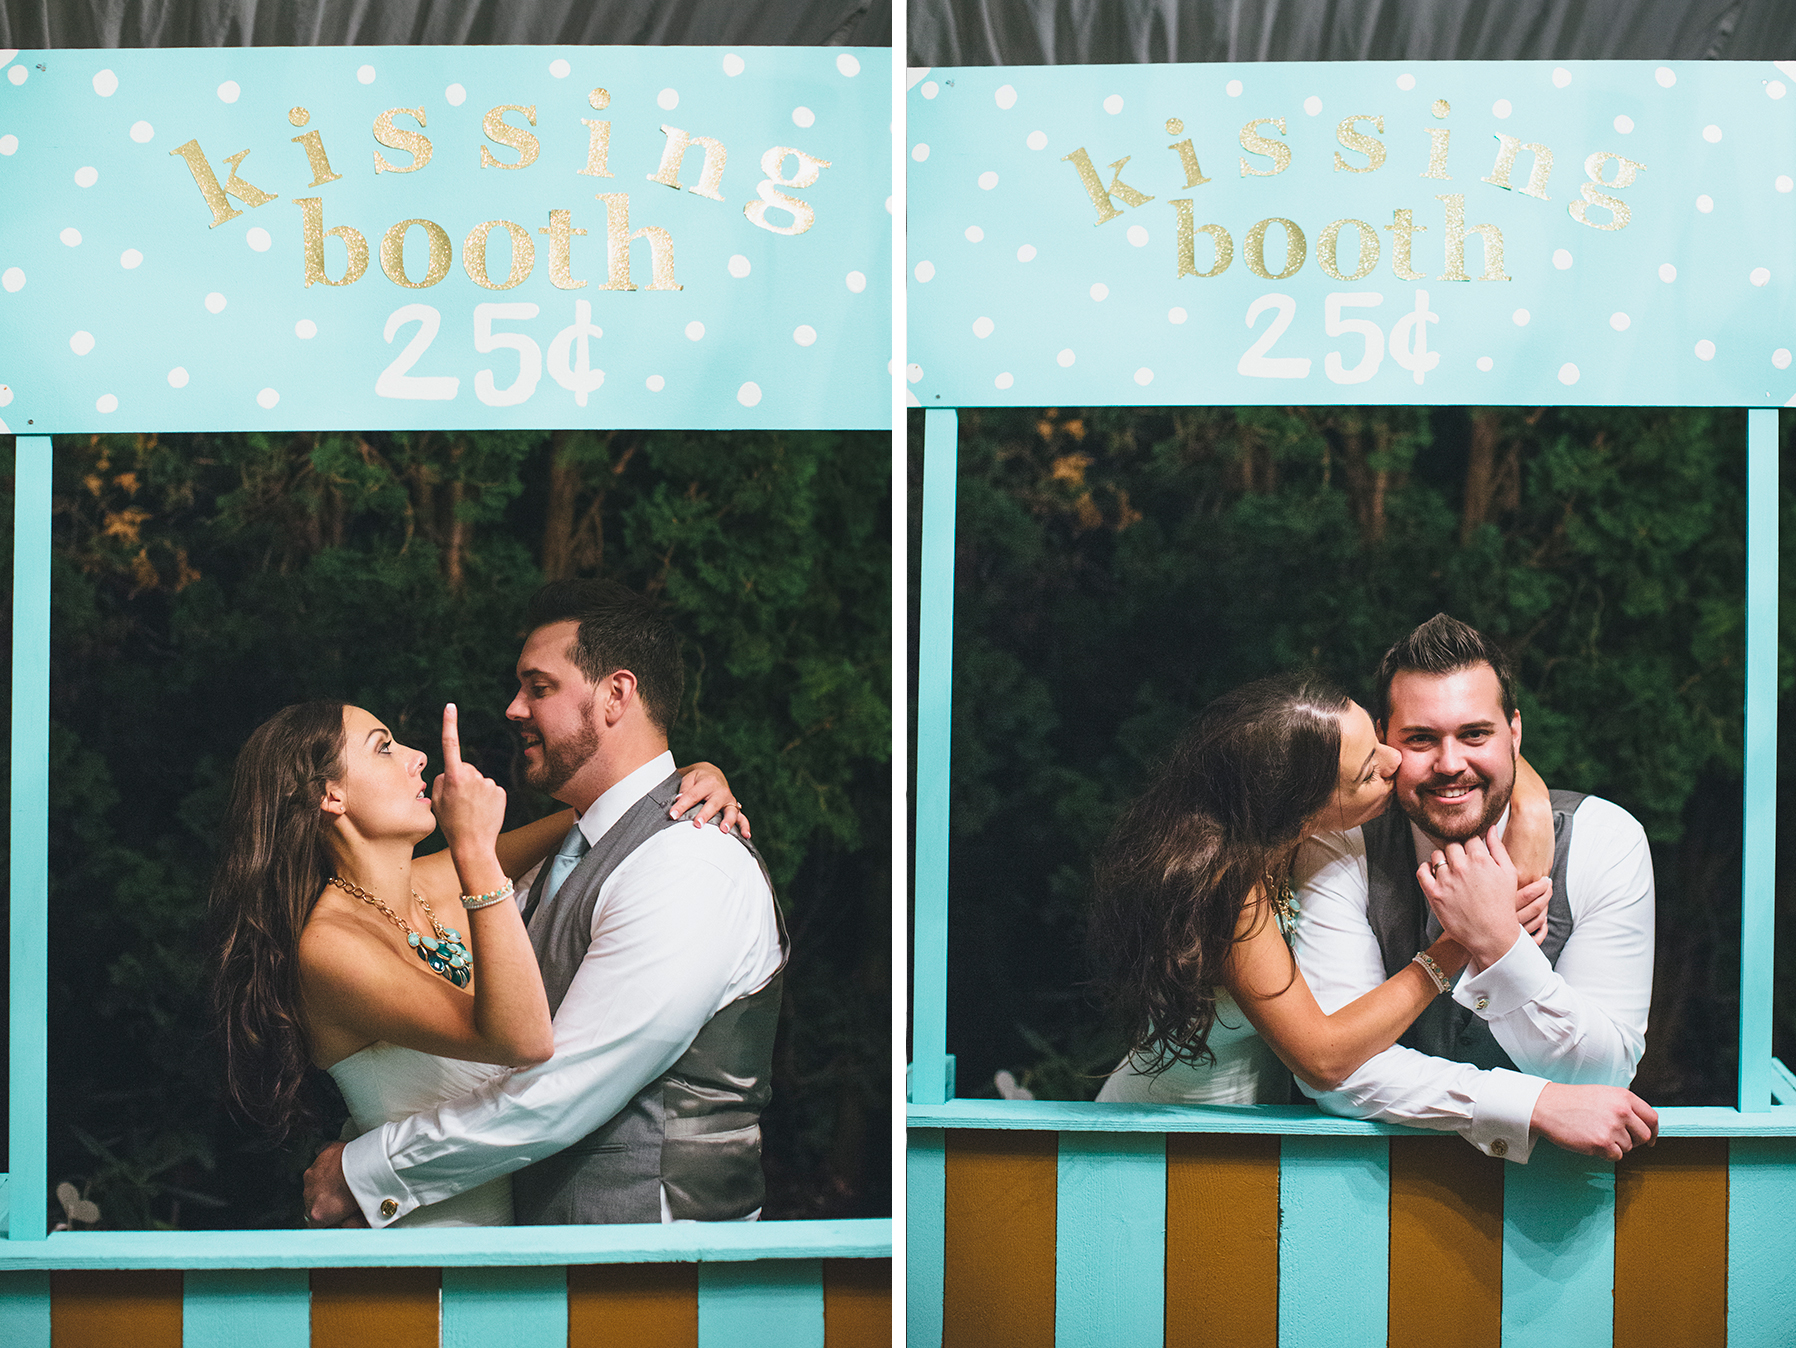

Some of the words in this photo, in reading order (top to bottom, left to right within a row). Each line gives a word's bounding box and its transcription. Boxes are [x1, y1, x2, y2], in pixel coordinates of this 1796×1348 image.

[169, 87, 831, 236] kissing
[1062, 98, 1648, 232] kissing
[292, 191, 684, 292] booth
[1169, 193, 1512, 282] booth
[376, 299, 606, 408] 25¢
[1237, 291, 1440, 385] 25¢
